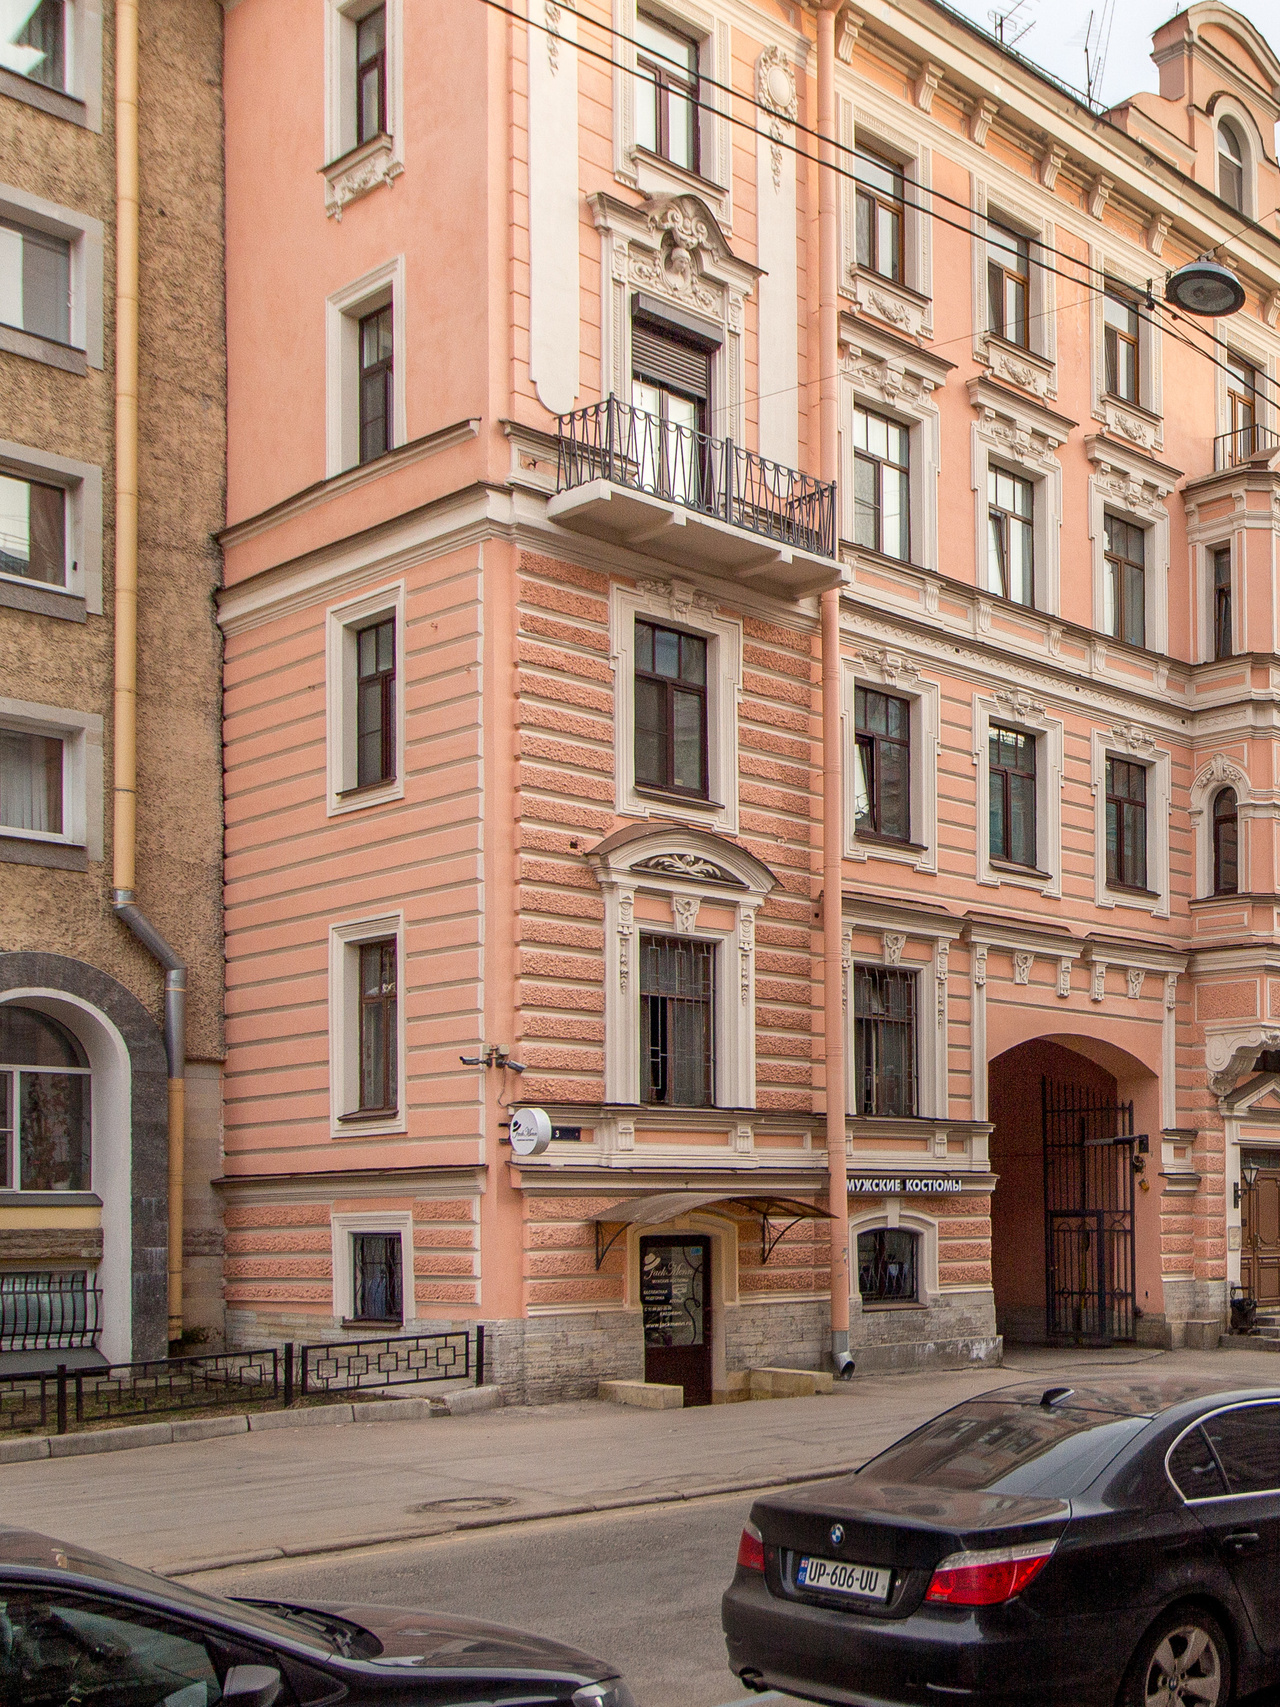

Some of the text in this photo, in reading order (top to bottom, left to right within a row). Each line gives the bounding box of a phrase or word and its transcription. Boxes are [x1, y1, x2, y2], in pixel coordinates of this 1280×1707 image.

[555, 1130, 560, 1138] 3
[846, 1178, 962, 1192] МУЖСКИЕ КОСТЮМЫ
[809, 1561, 879, 1592] UP-606-UU
